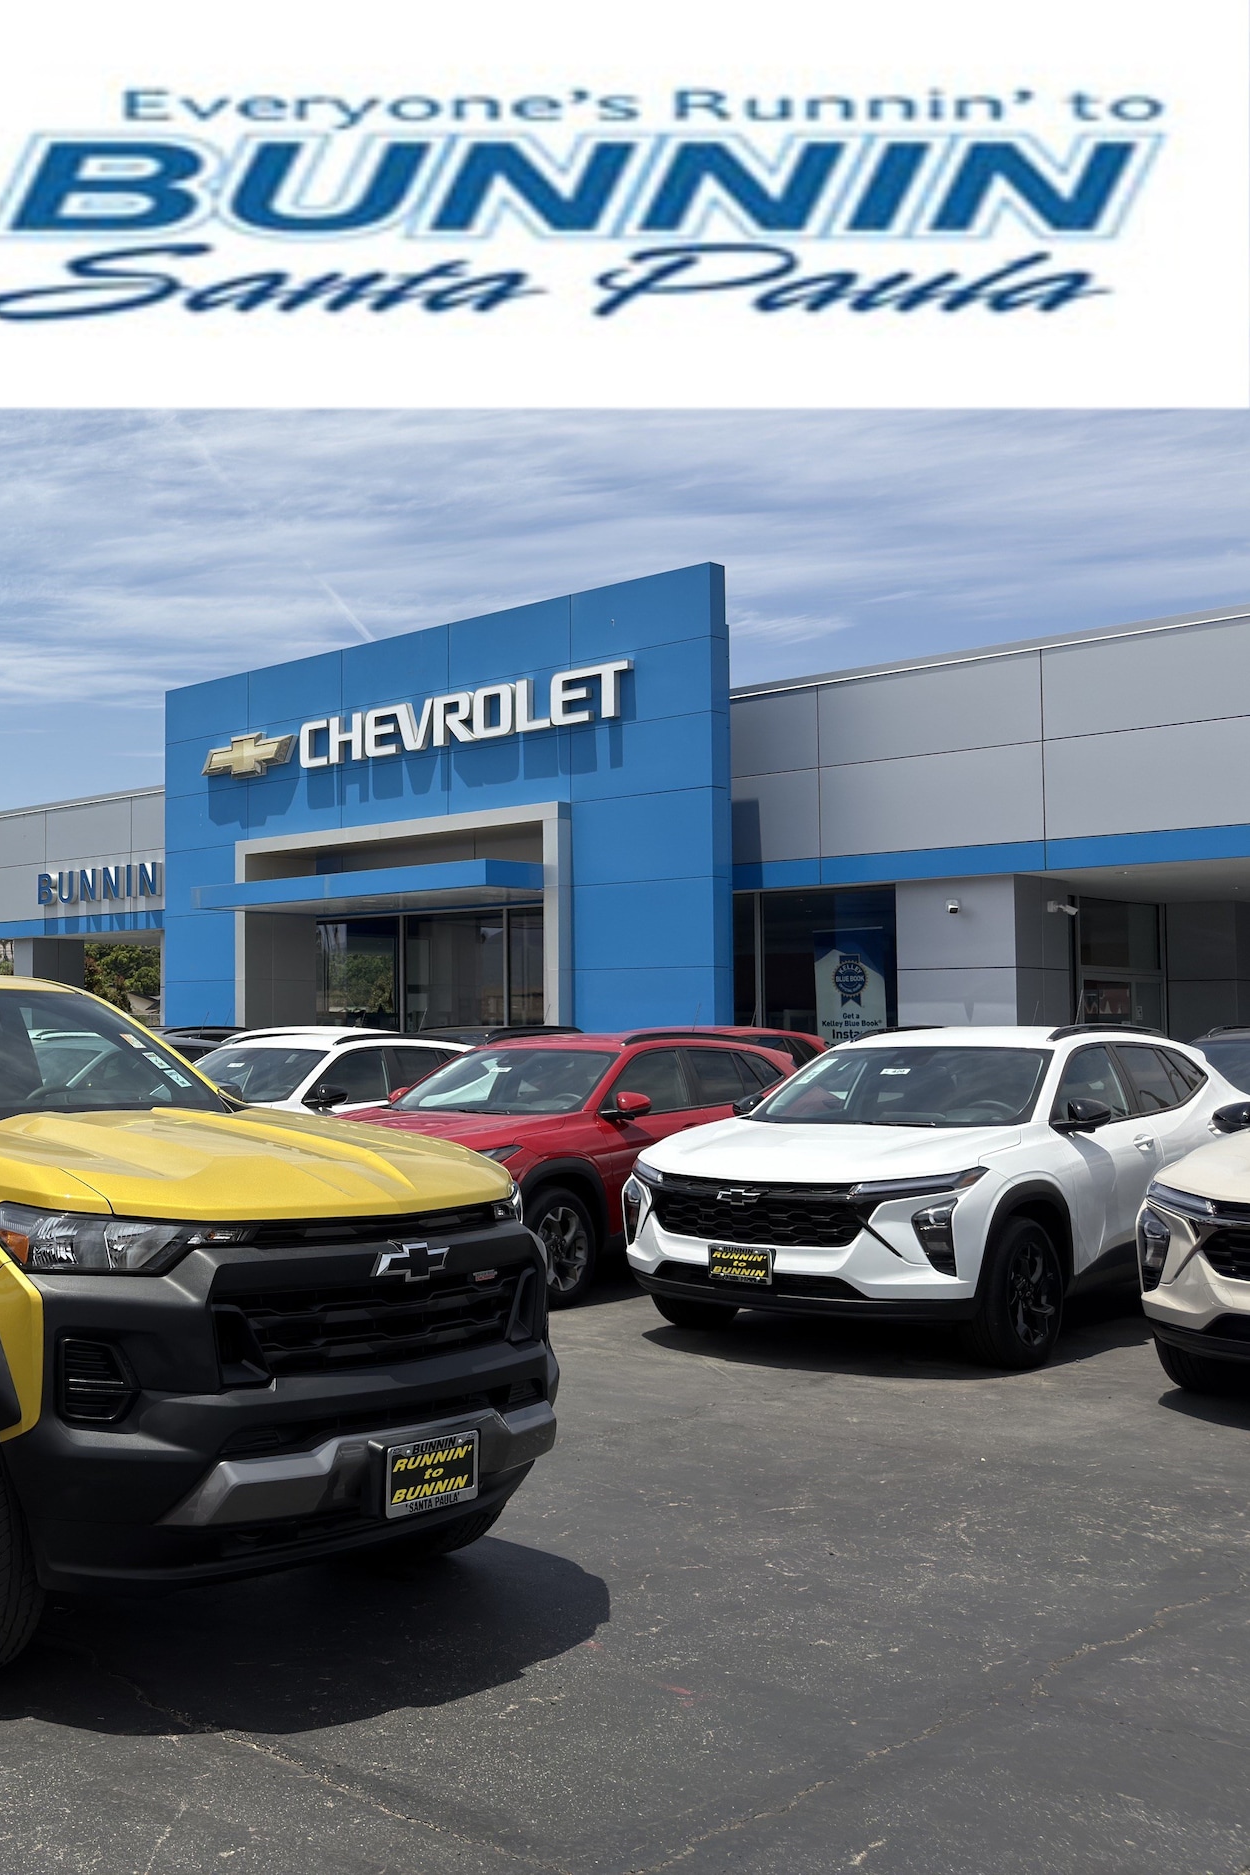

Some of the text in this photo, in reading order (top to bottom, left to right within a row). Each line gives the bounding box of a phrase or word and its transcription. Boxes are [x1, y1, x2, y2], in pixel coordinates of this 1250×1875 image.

[299, 658, 634, 769] CHEVROLET
[37, 862, 162, 905] BUNNIN
[839, 964, 863, 974] KELLEY
[835, 975, 865, 983] BLUE BOOK
[842, 1012, 855, 1020] Get
[821, 1020, 843, 1028] Kelley
[832, 1029, 863, 1039] Insta
[712, 1251, 767, 1262] RUNNIN'
[712, 1265, 766, 1277] BUNNIN
[412, 1436, 456, 1455] BUNNIN
[392, 1444, 473, 1473] RUNNIN'
[423, 1467, 444, 1480] to
[391, 1474, 469, 1504] BUNNIN
